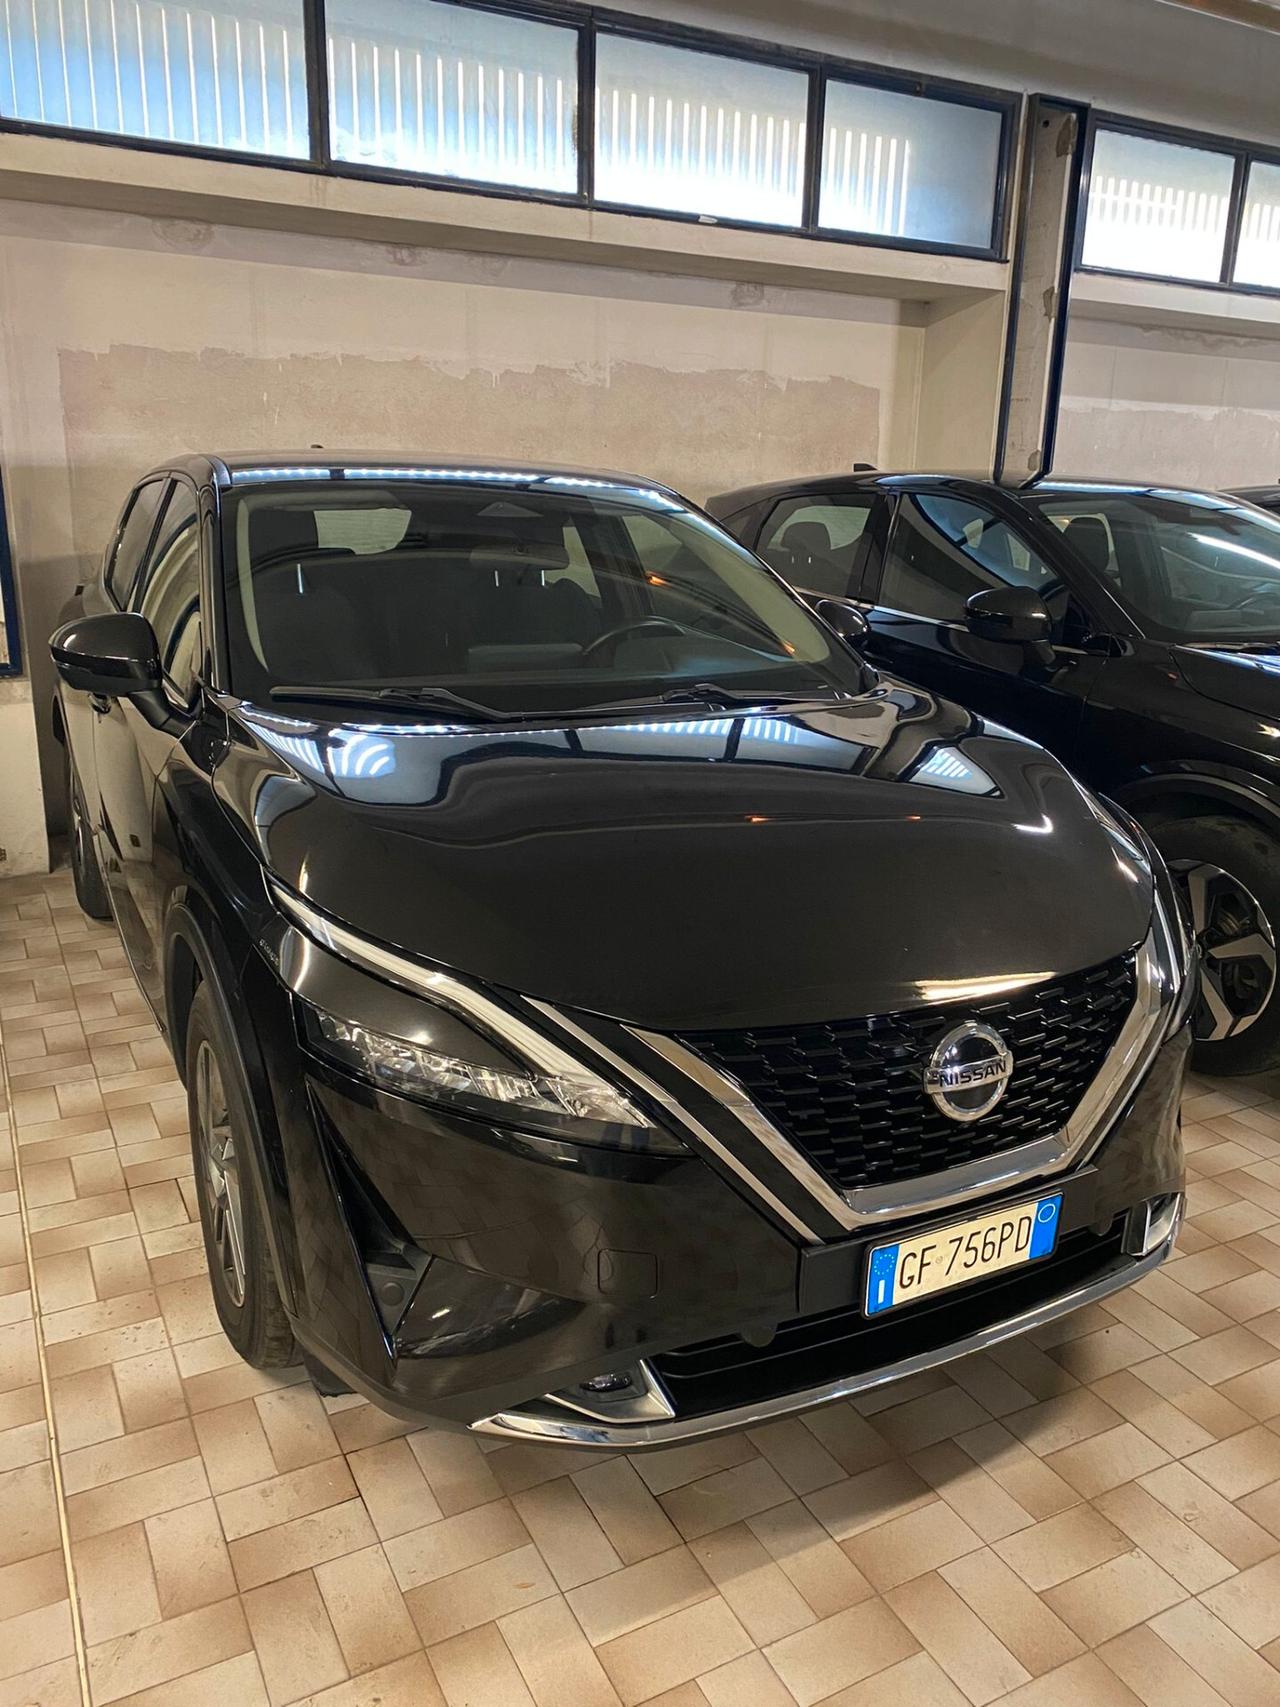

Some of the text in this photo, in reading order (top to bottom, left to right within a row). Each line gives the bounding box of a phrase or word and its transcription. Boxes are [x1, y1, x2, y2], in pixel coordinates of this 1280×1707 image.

[940, 1060, 1006, 1087] NISSAN
[899, 1216, 1032, 1289] GF 756PD
